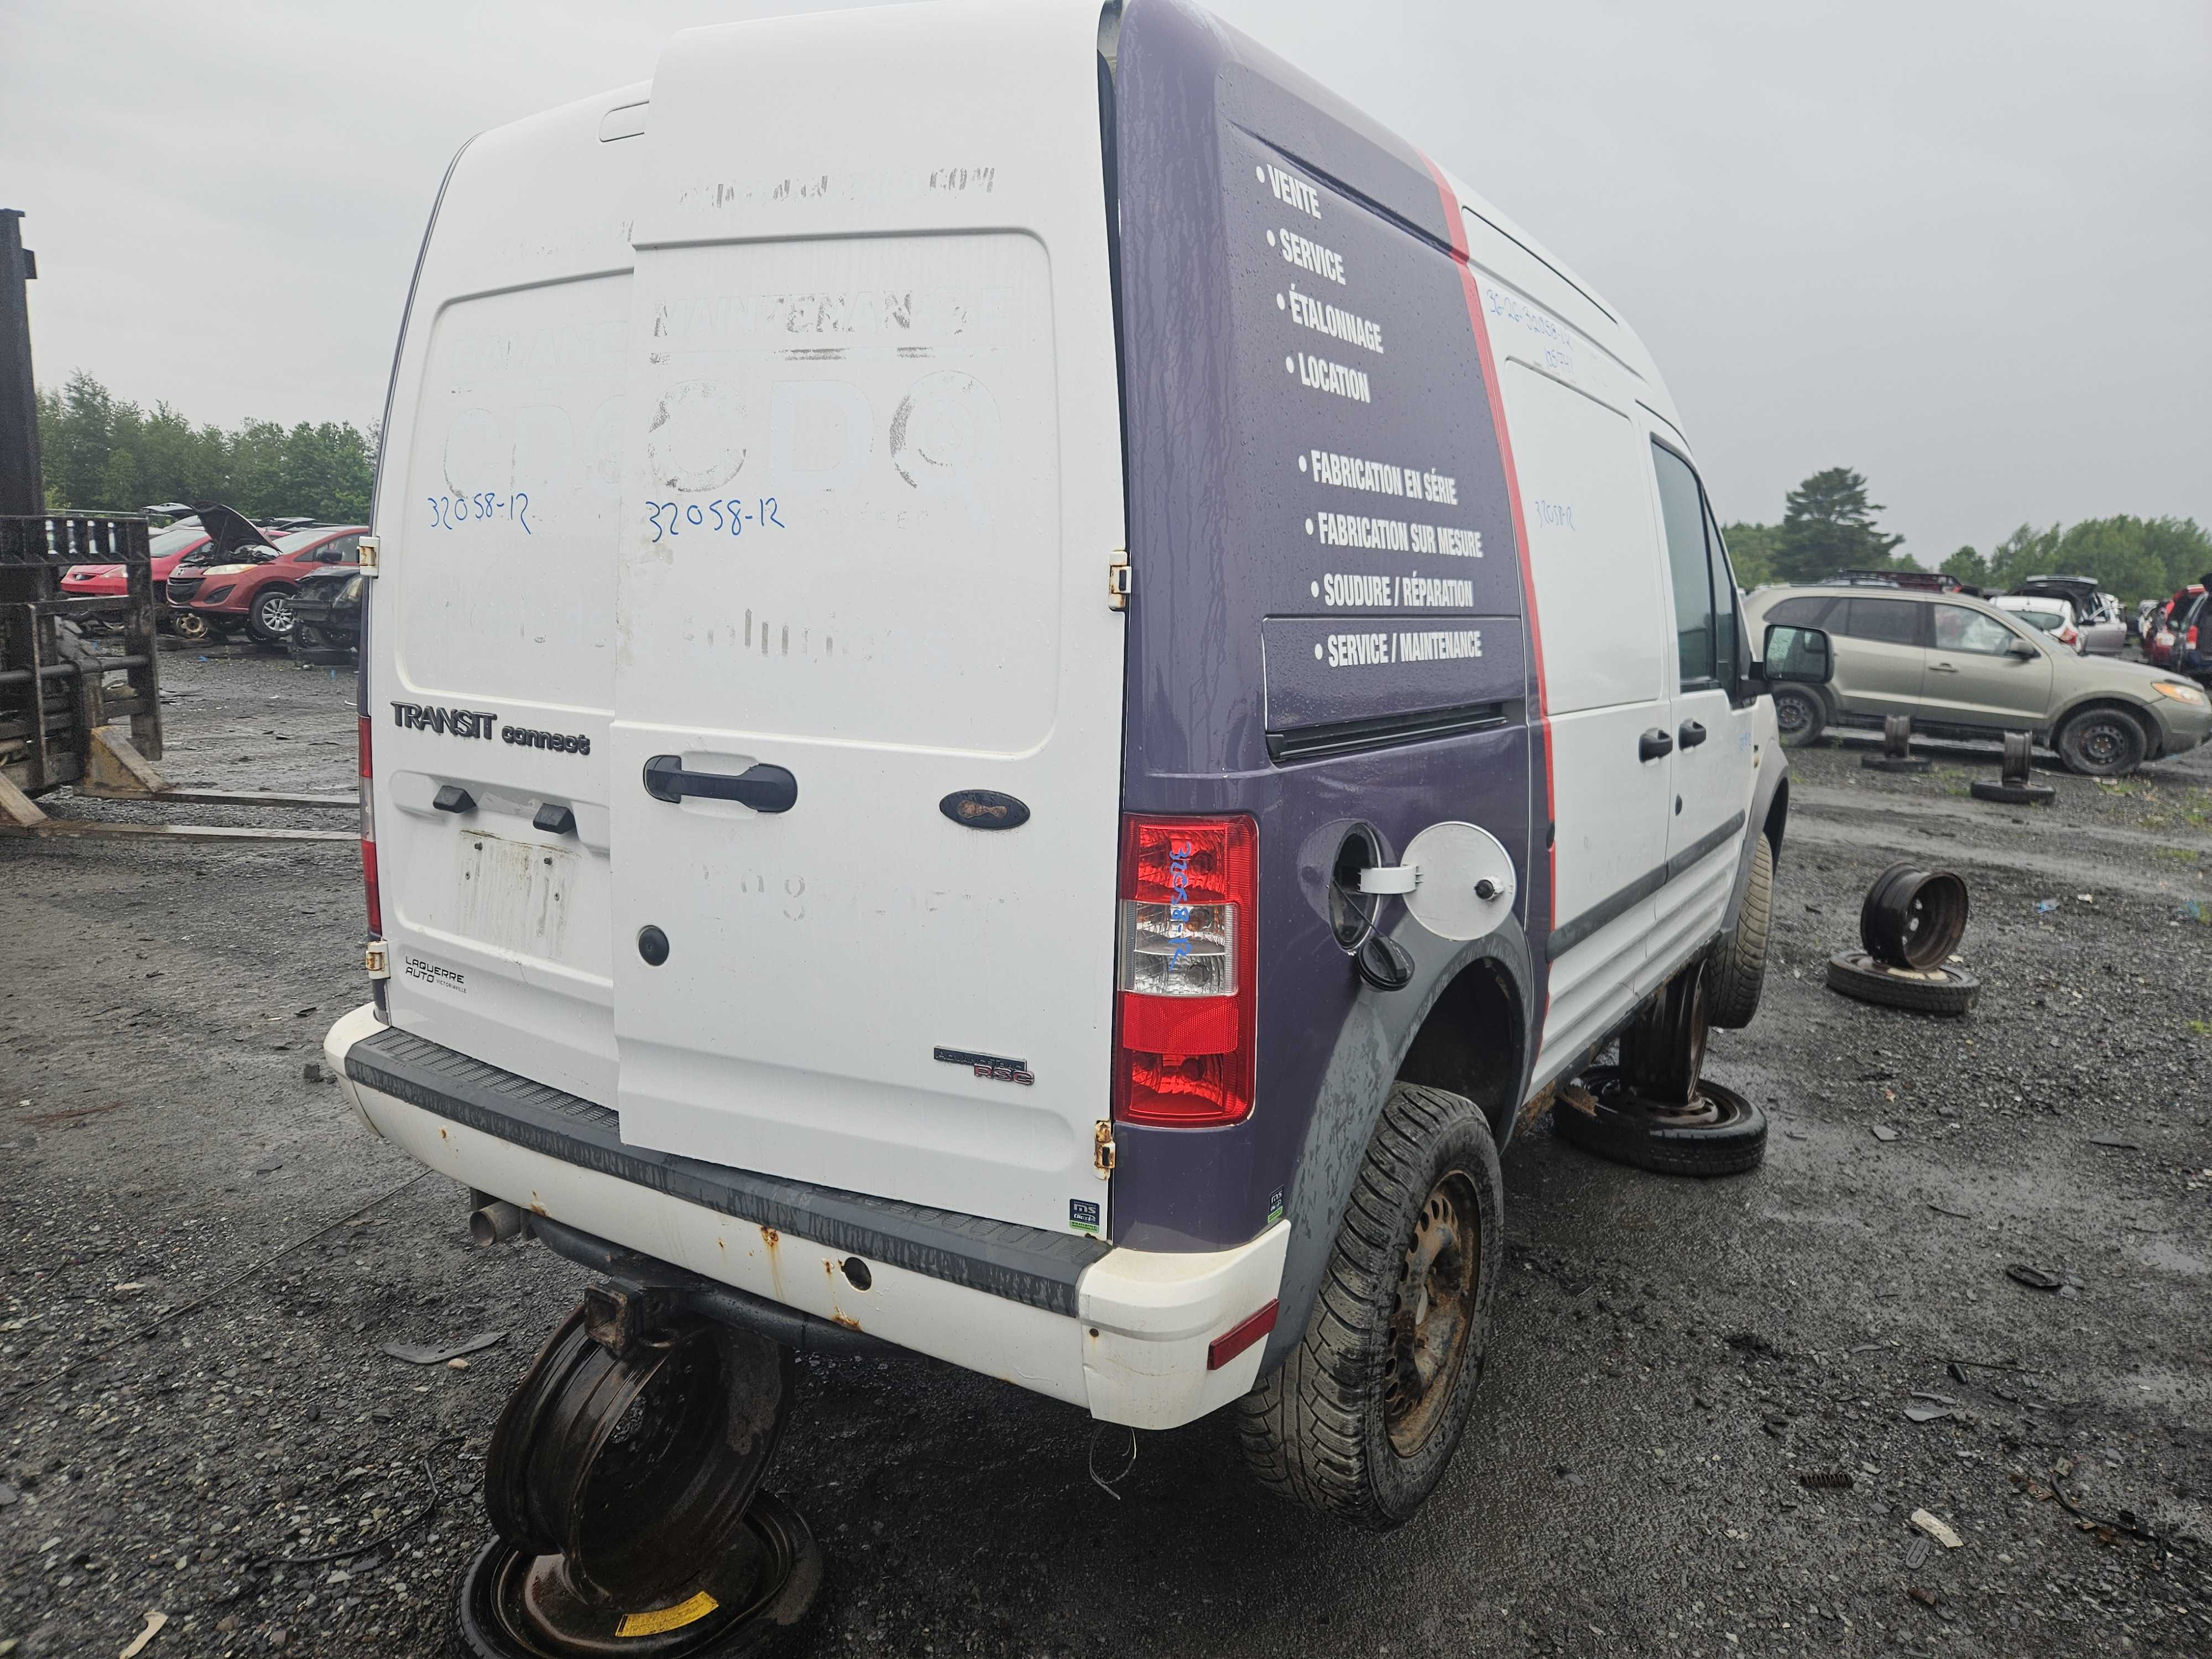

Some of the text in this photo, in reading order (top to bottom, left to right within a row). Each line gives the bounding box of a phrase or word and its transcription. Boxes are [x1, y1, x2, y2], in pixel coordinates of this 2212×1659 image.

[1267, 164, 1321, 219] VENTE
[1280, 228, 1345, 285] SERVICE
[1288, 283, 1383, 354] ÉTALONNAGE
[1298, 353, 1370, 403] LOCATION
[1311, 450, 1458, 505] FABRICATION EN SÉRIE
[427, 493, 531, 534] 32058-12
[645, 498, 785, 542] 32058-12
[1318, 512, 1483, 557] FABRICATION SUR MESURE
[1324, 573, 1391, 606] SOUDURE
[1402, 571, 1473, 607] RÉPARATION
[1328, 634, 1388, 667] SERVICE
[1400, 630, 1482, 661] MAINTENANCE
[390, 701, 590, 755] TRANSIT connect
[405, 967, 467, 993] AUTO VICTORIAVILLE
[974, 1064, 1035, 1086] RSC
